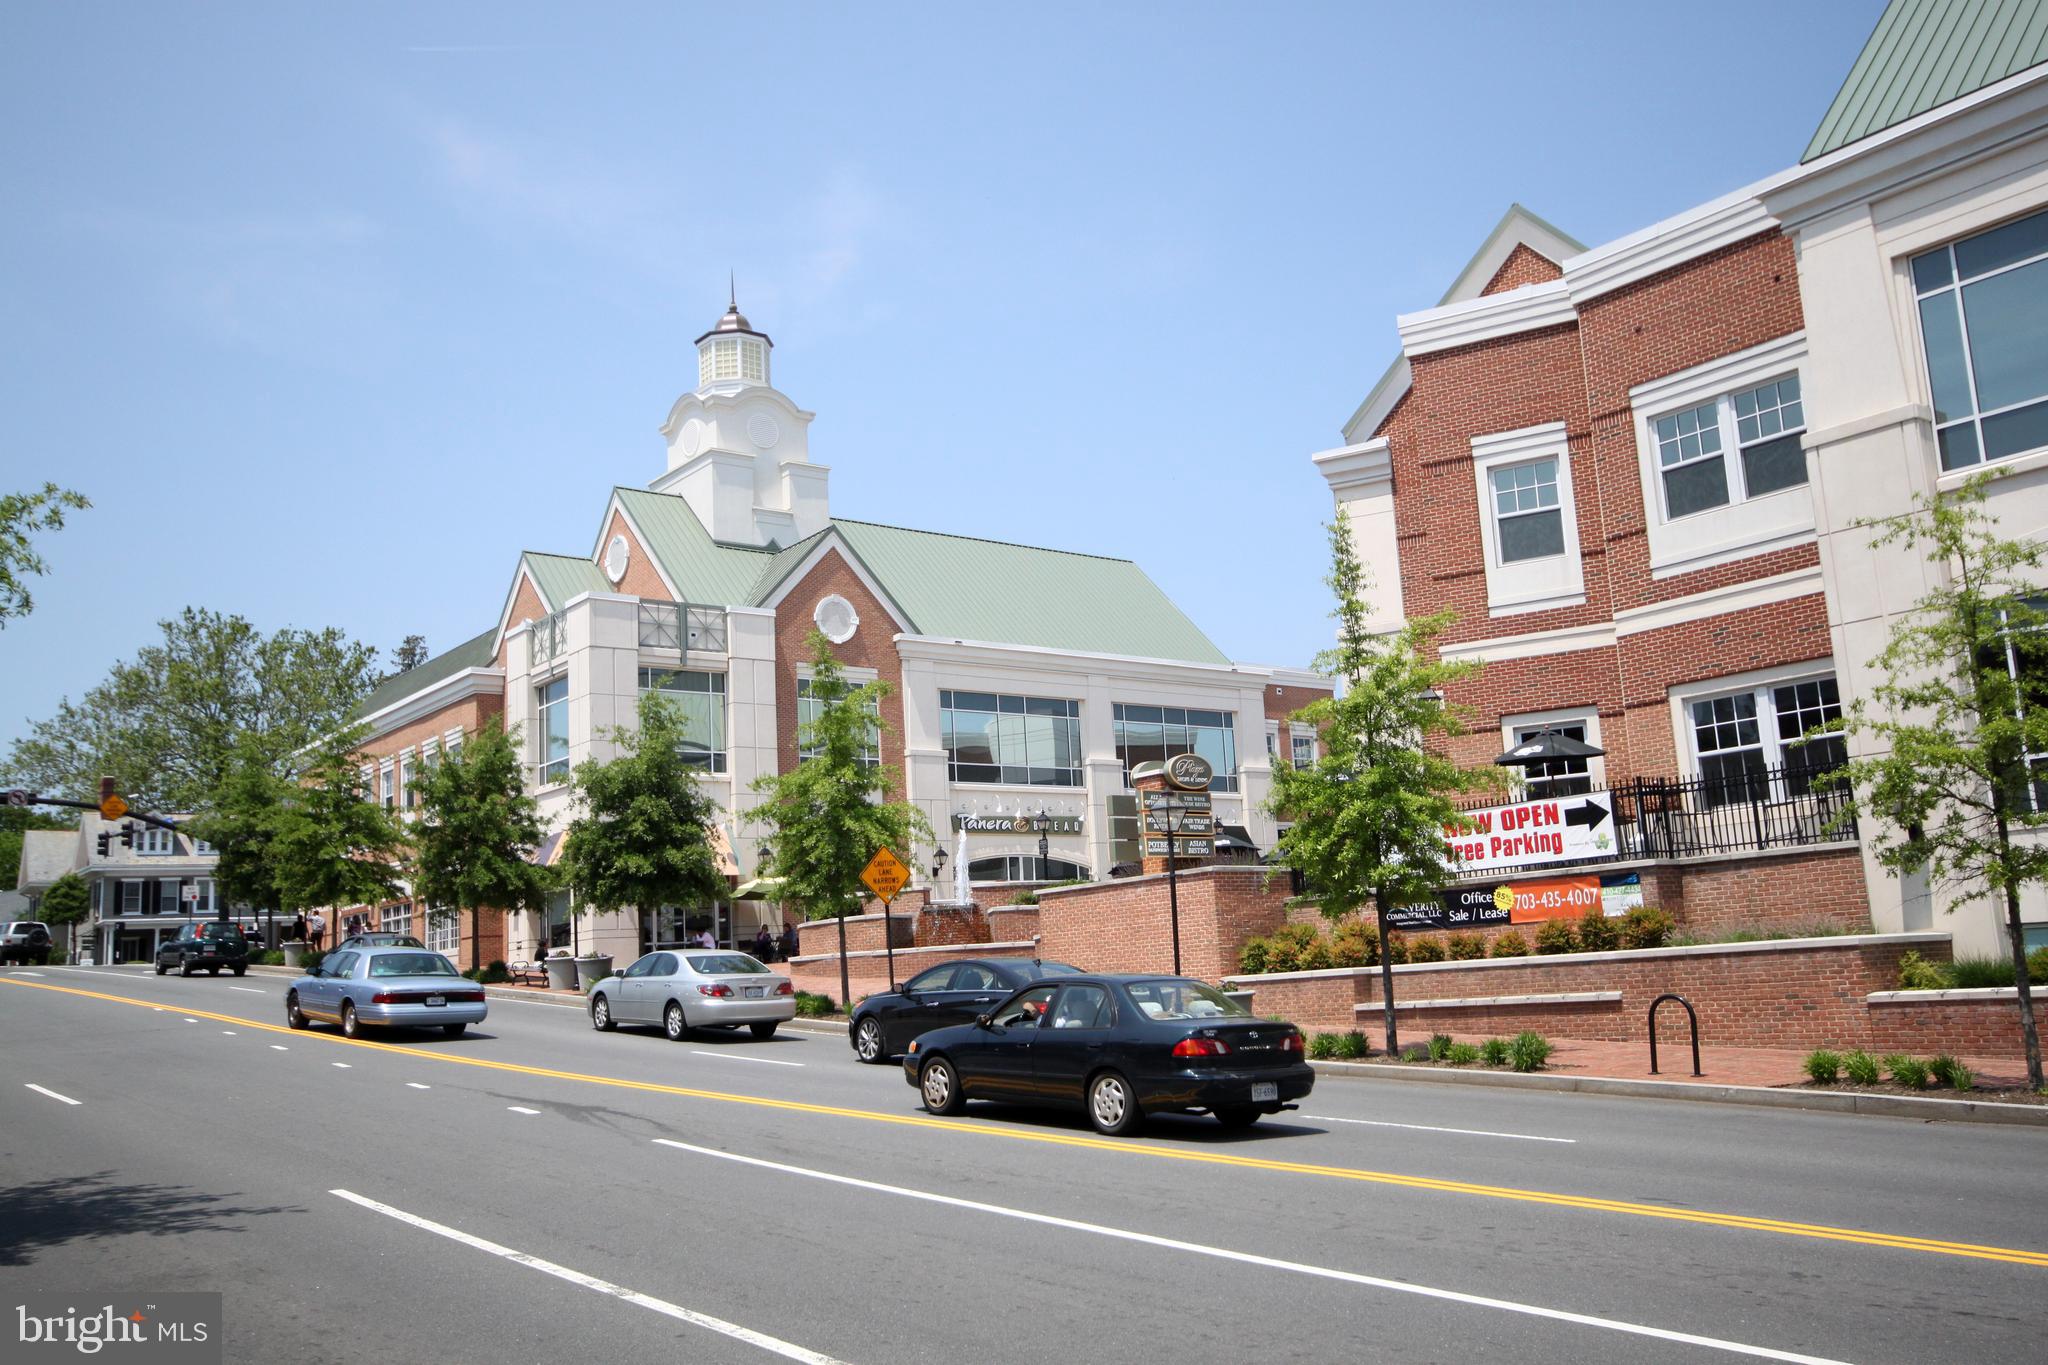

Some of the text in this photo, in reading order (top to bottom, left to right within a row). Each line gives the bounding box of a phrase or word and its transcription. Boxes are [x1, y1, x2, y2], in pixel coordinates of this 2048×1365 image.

[957, 813, 1079, 832] Panera BEAD
[1501, 803, 1560, 831] OPEN
[1490, 832, 1562, 858] Parking
[1461, 891, 1493, 904] Office
[1515, 888, 1598, 910] 703-435-4007
[1448, 909, 1469, 922] Sale
[1480, 907, 1509, 919] Lease
